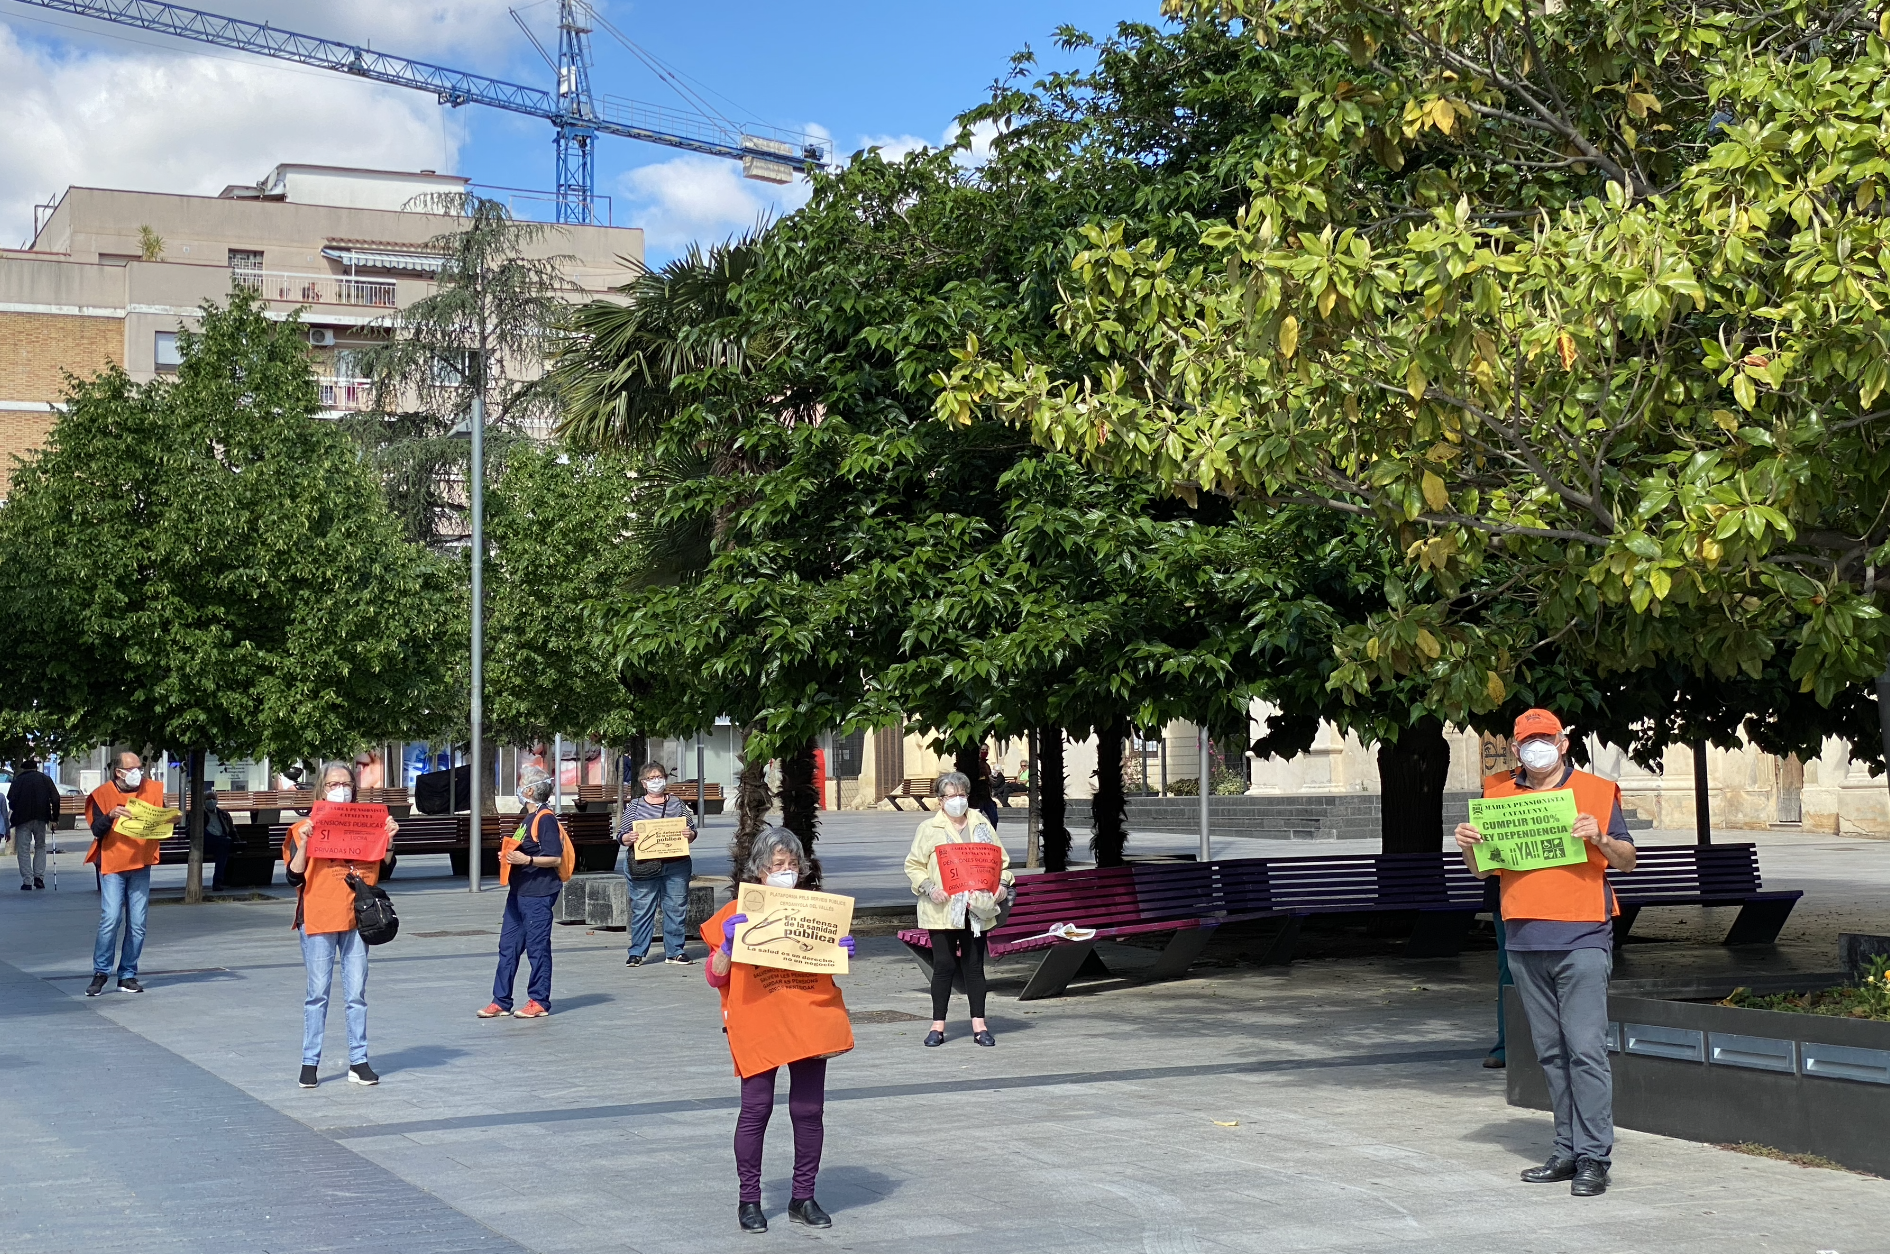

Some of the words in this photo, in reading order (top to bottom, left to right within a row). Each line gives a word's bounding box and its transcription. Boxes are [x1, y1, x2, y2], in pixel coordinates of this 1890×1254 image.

[1484, 803, 1512, 811] MAREA
[1514, 796, 1565, 808] PENSIONISTA
[1502, 806, 1549, 817] CATALUNYA
[1482, 818, 1529, 830] CUMPLIR
[1530, 814, 1560, 826] 100%
[1497, 825, 1568, 840] DEPENDENCIA
[800, 917, 838, 928] defensa
[807, 924, 838, 935] sanidad
[784, 928, 835, 944] pública
